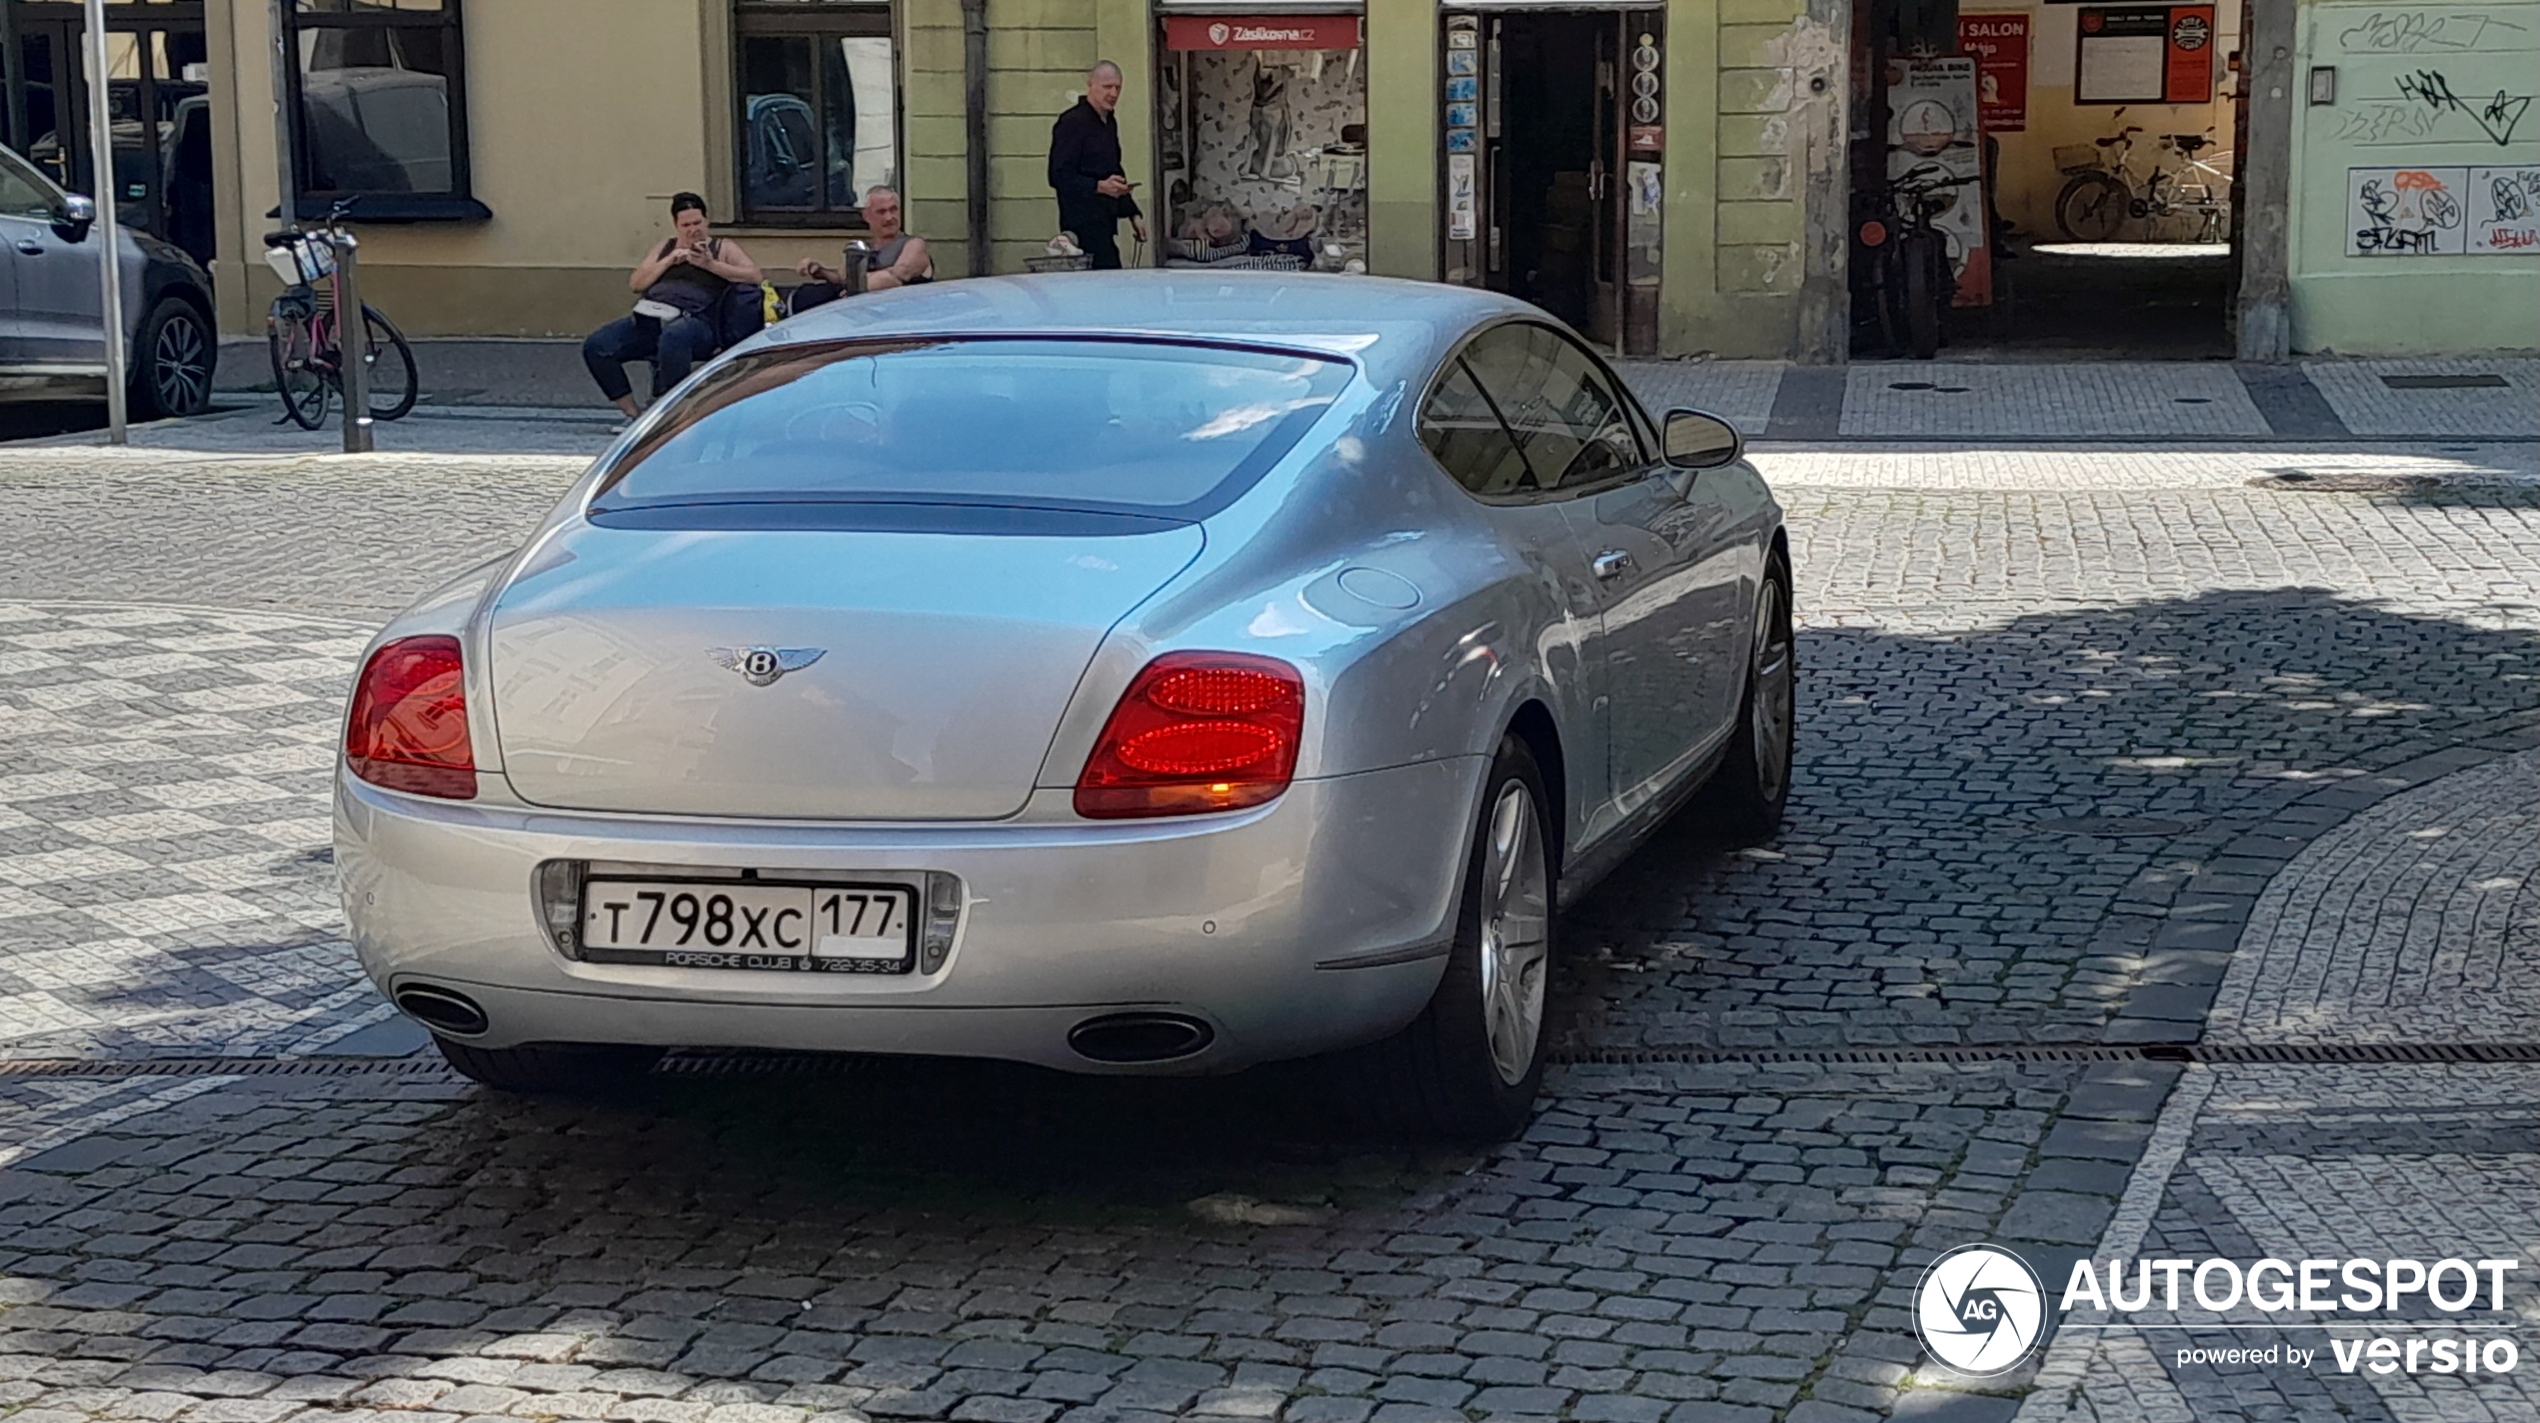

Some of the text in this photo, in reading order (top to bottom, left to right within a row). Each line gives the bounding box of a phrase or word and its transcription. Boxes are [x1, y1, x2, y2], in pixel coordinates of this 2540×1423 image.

[1968, 23, 2024, 37] SALON
[820, 894, 897, 937] 177
[665, 952, 741, 968] PORSCHE
[747, 955, 792, 970] CLUB
